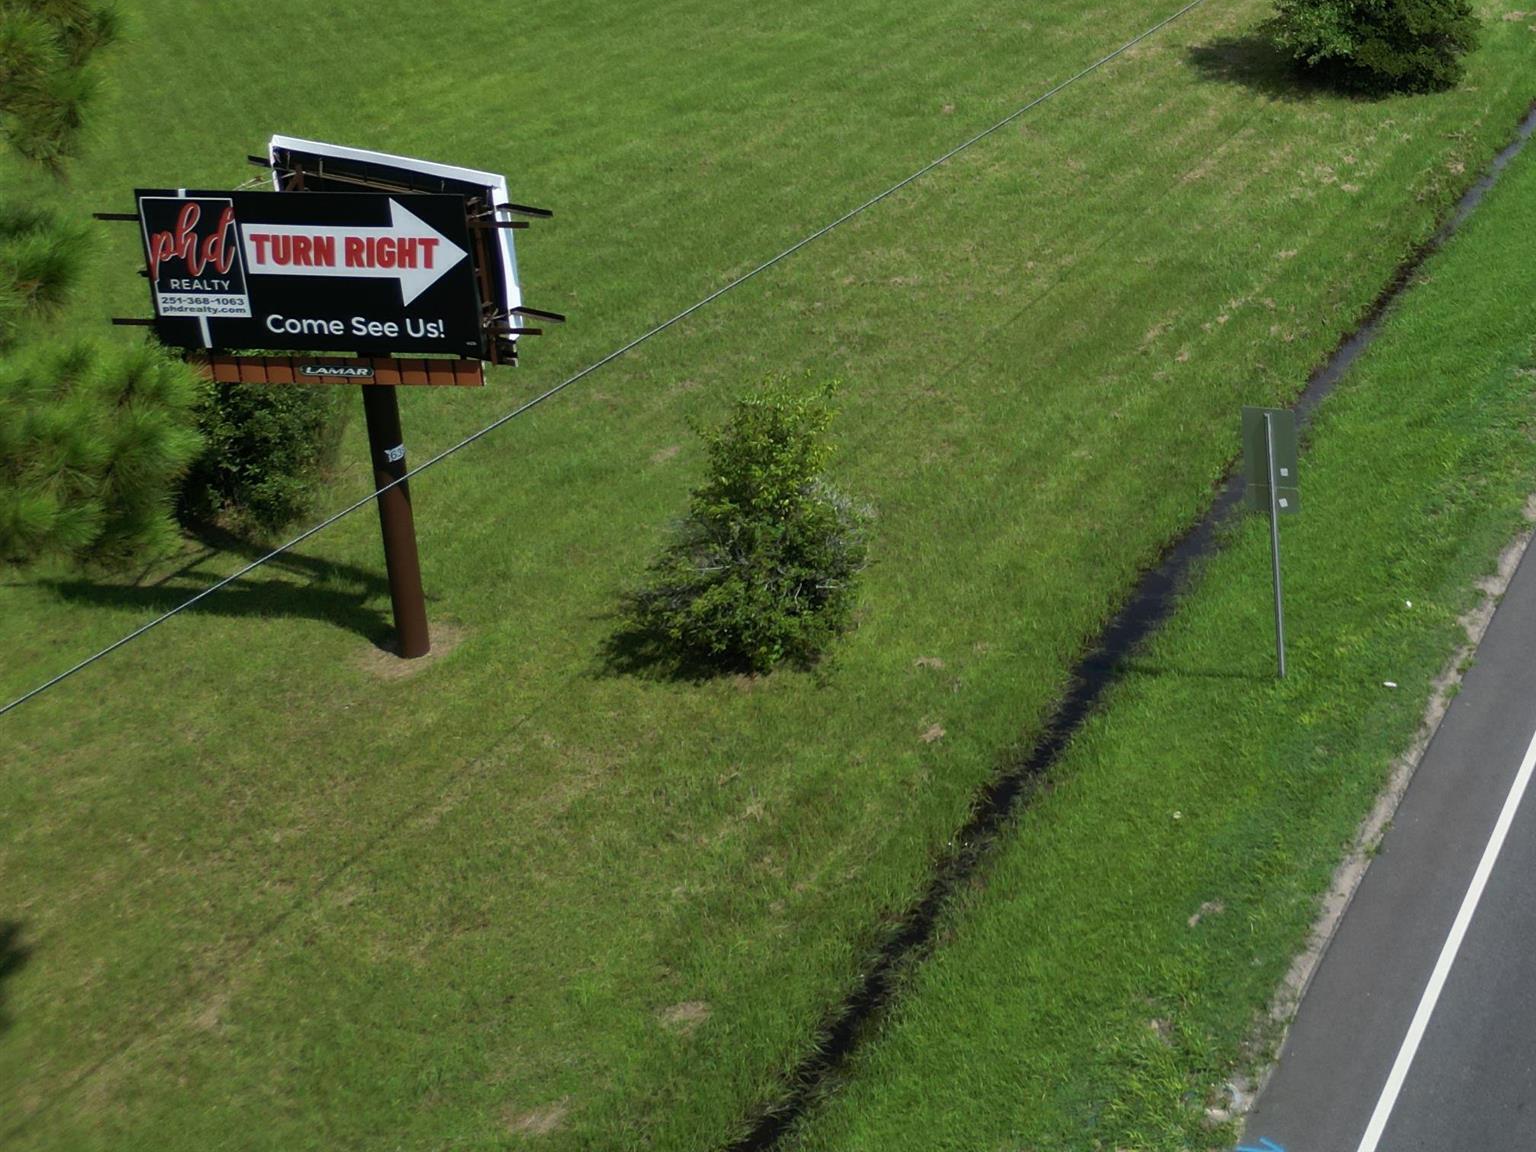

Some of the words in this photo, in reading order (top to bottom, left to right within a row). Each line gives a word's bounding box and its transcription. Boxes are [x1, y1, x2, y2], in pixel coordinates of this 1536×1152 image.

[149, 202, 236, 280] phd
[250, 233, 336, 267] TURN
[344, 235, 439, 269] RIGHT
[170, 278, 230, 291] REALTY
[161, 296, 244, 306] 251-368-1063
[162, 305, 246, 314] phdrealty.com
[266, 314, 344, 335] Come
[352, 316, 398, 337] See
[406, 318, 445, 338] Us!
[306, 365, 369, 377] LAMAR
